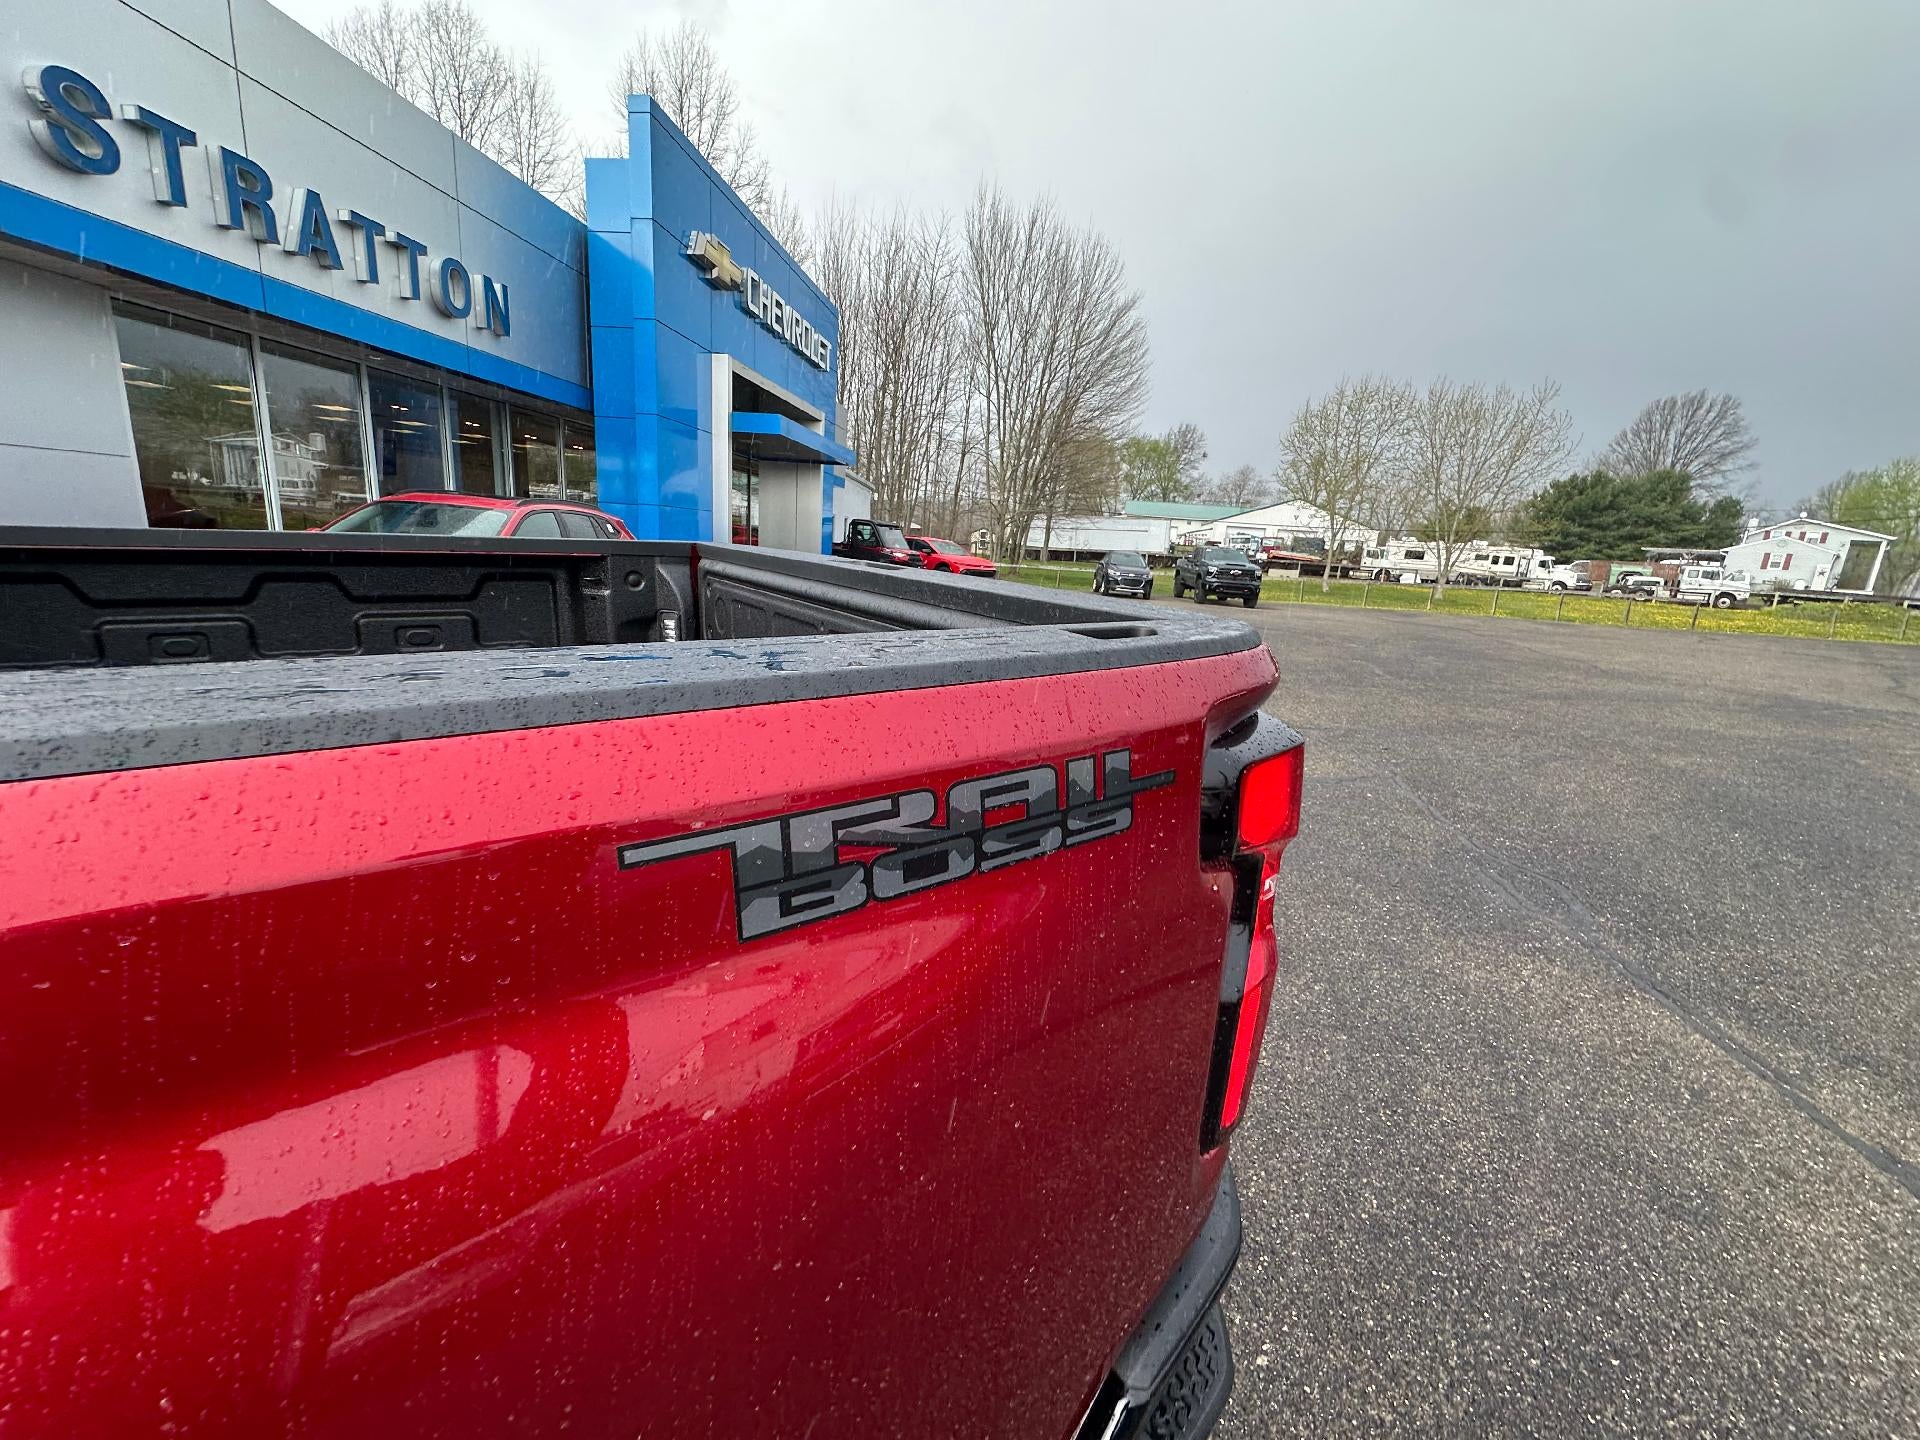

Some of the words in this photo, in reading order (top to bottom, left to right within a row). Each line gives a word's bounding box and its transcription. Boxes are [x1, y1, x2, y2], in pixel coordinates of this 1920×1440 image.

[22, 64, 511, 336] STRATTON
[741, 267, 832, 371] CHEVROLET
[617, 748, 1176, 888] TRAIL
[736, 802, 1134, 942] BOSS
